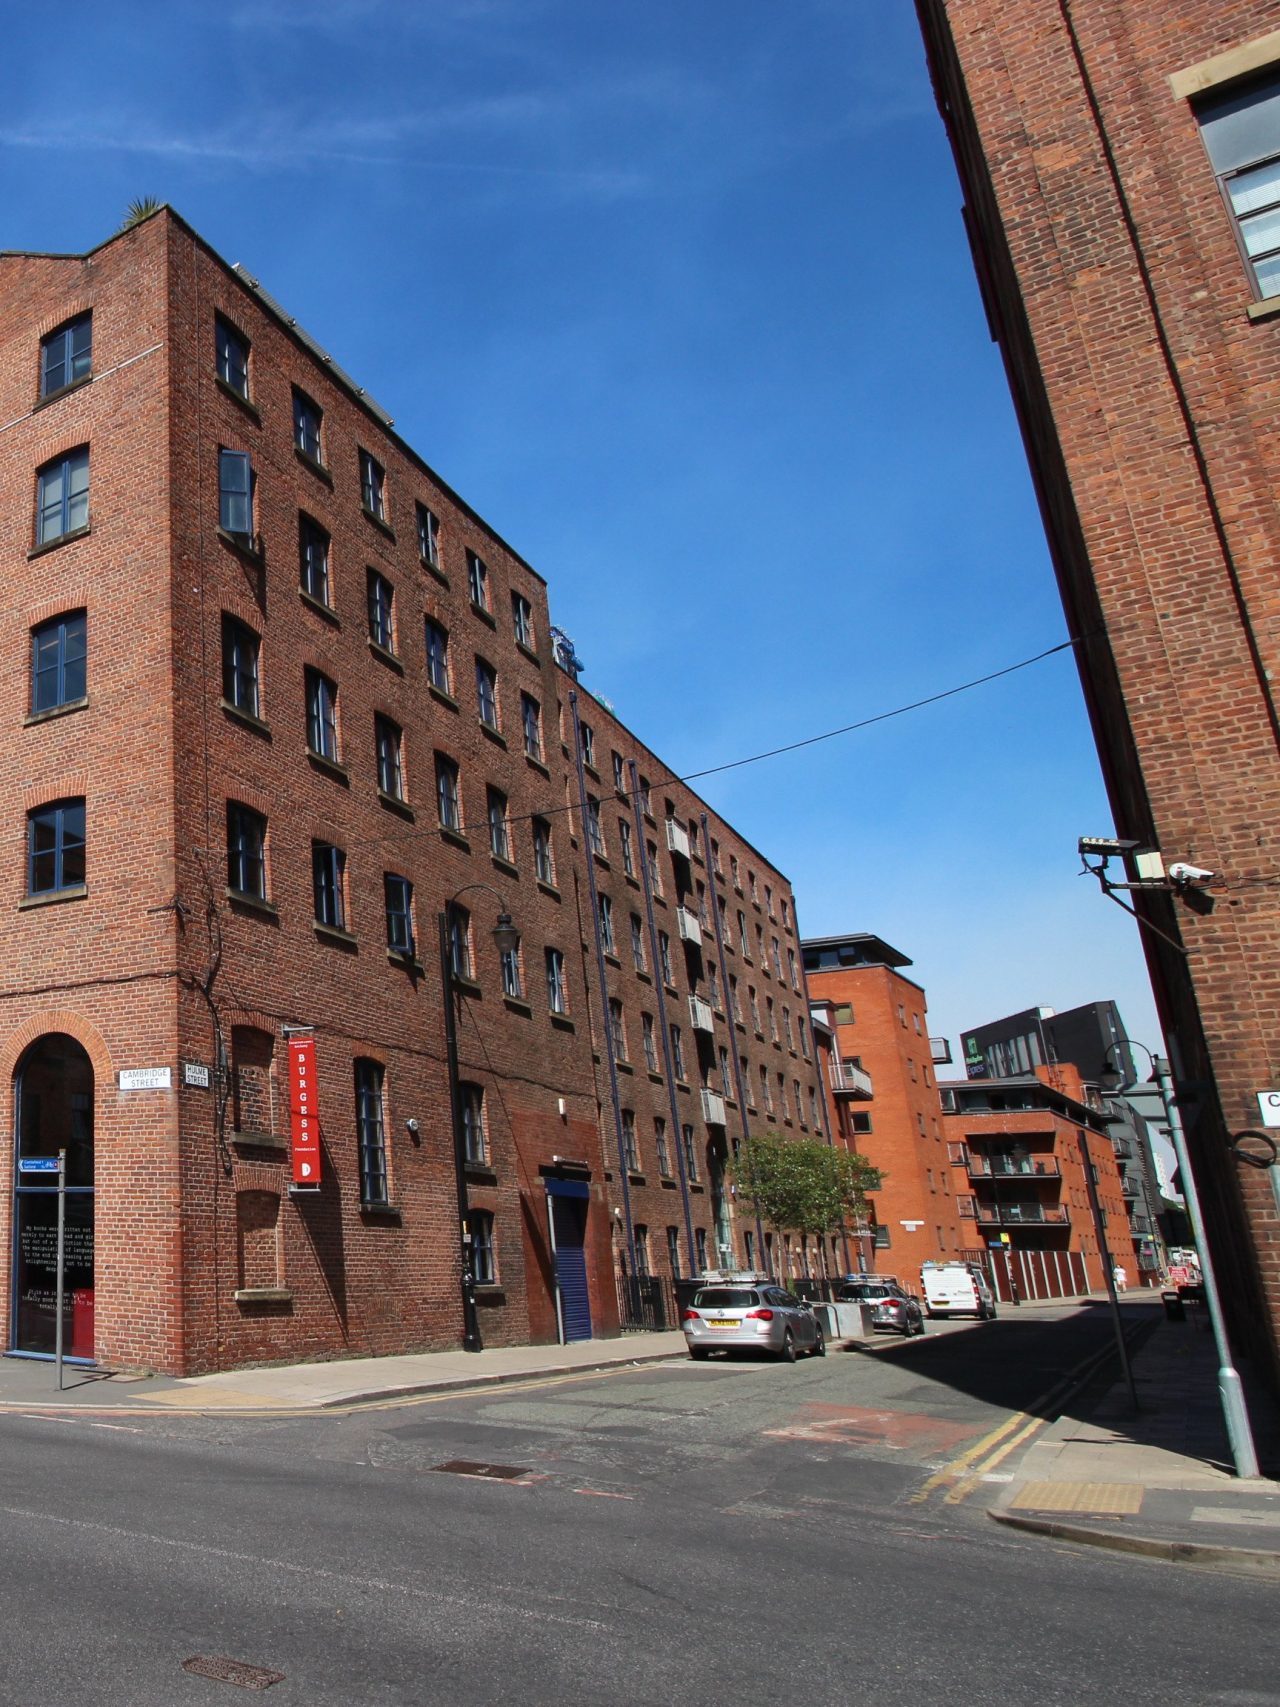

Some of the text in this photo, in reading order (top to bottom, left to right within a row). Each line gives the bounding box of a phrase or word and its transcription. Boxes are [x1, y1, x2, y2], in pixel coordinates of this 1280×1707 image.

[123, 1069, 167, 1079] CAMBRIDGE
[187, 1066, 206, 1077] HULME
[131, 1078, 159, 1088] STREET
[187, 1075, 207, 1085] STREET
[298, 1053, 309, 1141] BURGESS
